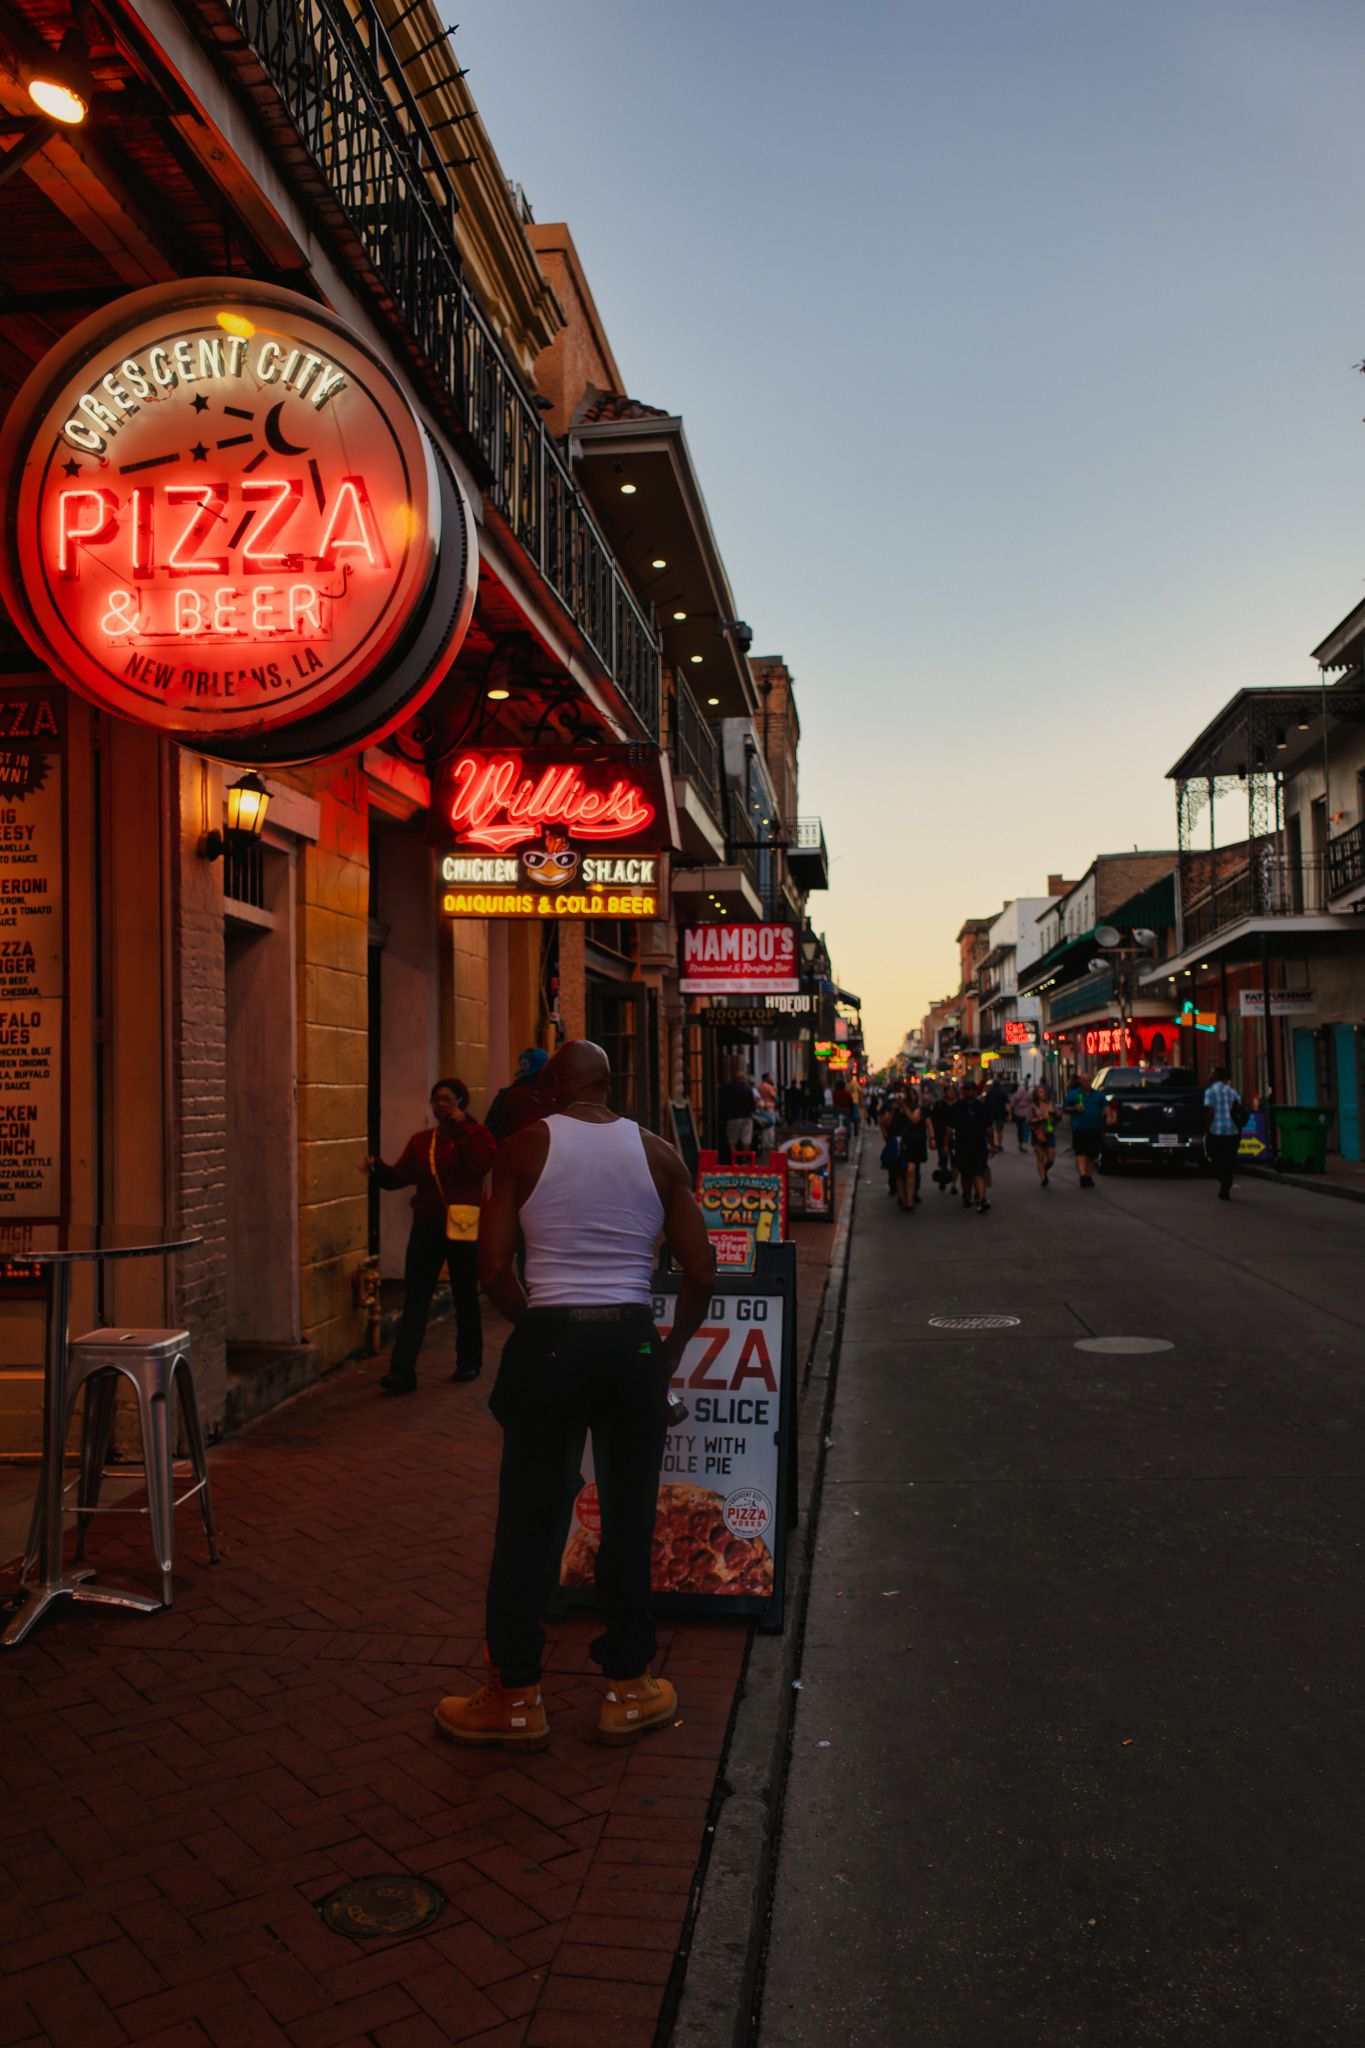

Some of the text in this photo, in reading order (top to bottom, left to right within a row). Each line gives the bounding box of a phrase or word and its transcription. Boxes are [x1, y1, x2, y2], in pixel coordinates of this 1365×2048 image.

[64, 335, 347, 453] CRESCENT CITY
[58, 475, 391, 582] PIZZA
[101, 584, 320, 636] & BEER
[123, 652, 176, 690] NEW
[292, 647, 324, 678] LA
[16, 754, 29, 767] IN
[451, 753, 655, 832] Willie's
[0, 825, 35, 840] ESY
[11, 855, 38, 864] SAUCE
[442, 857, 655, 883] CHICKEN SHACK
[20, 906, 52, 915] TOMATO
[443, 894, 654, 914] DAIQUIRIS & COLD BEER
[684, 927, 794, 962] MAMBO'S
[9, 976, 29, 985] BEEF,
[1, 987, 42, 997] CHEDDAR,
[1245, 993, 1263, 1001] FAT
[706, 1009, 777, 1020] ROOFTOP
[31, 1046, 52, 1056] BLUE
[19, 1058, 50, 1068] ONIONS,
[14, 1069, 50, 1079] BUFFALO
[5, 1082, 31, 1091] SAUCE
[0, 1139, 35, 1155] NCH
[23, 1157, 52, 1167] KETTLE
[0, 1170, 45, 1179] ZZARELLA,
[14, 1181, 42, 1190] RANCH
[704, 1176, 779, 1191] WORLD FAMOUS
[703, 1188, 777, 1210] COCK
[721, 1210, 756, 1225] TAIL
[736, 1298, 768, 1322] GO
[695, 1398, 770, 1426] SLICE
[704, 1436, 746, 1455] WITH
[662, 1455, 732, 1475] OLE PIE
[727, 1507, 767, 1521] PIZZA
[731, 1520, 763, 1528] WORKS
